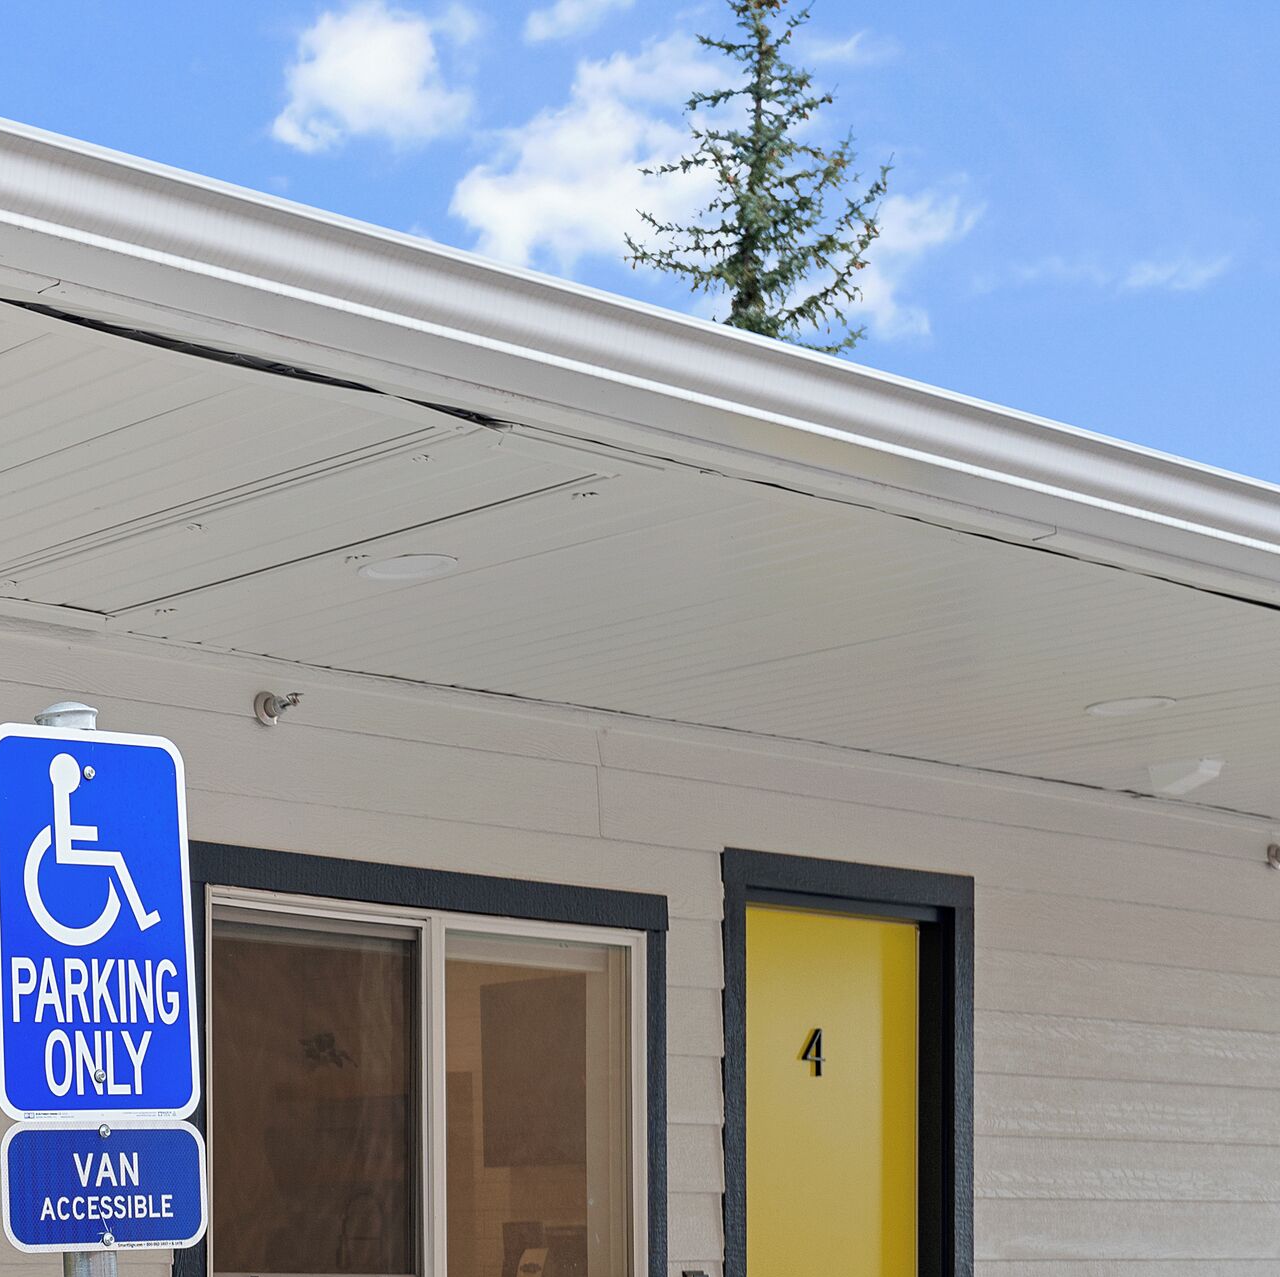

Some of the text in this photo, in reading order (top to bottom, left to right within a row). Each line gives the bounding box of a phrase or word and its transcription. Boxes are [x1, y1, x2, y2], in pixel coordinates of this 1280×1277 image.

[11, 957, 180, 1025] PARKING
[44, 1029, 153, 1097] ONLY
[800, 1028, 826, 1077] 4
[73, 1152, 140, 1188] VAN
[40, 1194, 174, 1221] ACCESSIBLE
